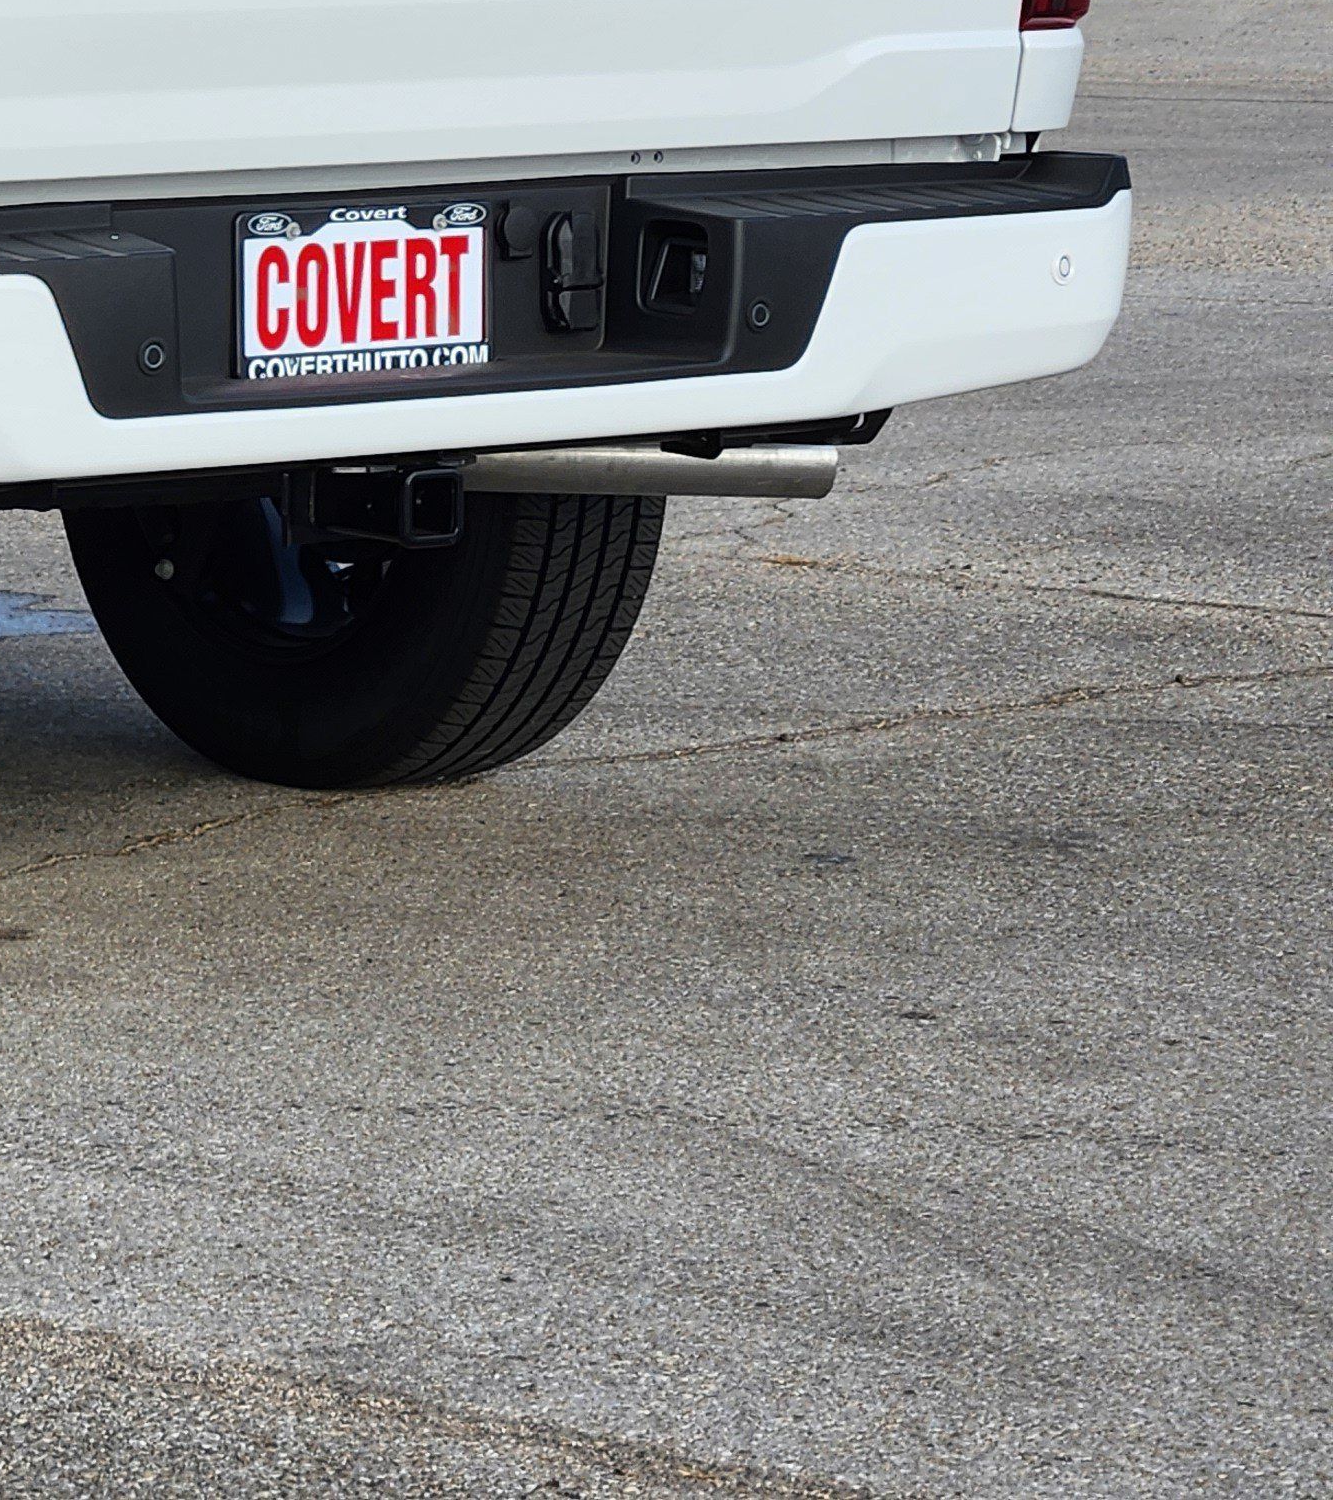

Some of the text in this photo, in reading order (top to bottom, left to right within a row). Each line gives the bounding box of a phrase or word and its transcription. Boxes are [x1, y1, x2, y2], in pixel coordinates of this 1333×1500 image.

[329, 206, 408, 221] Covert
[257, 235, 469, 351] COVERT
[248, 344, 488, 379] COVERTHUTTOCOM
